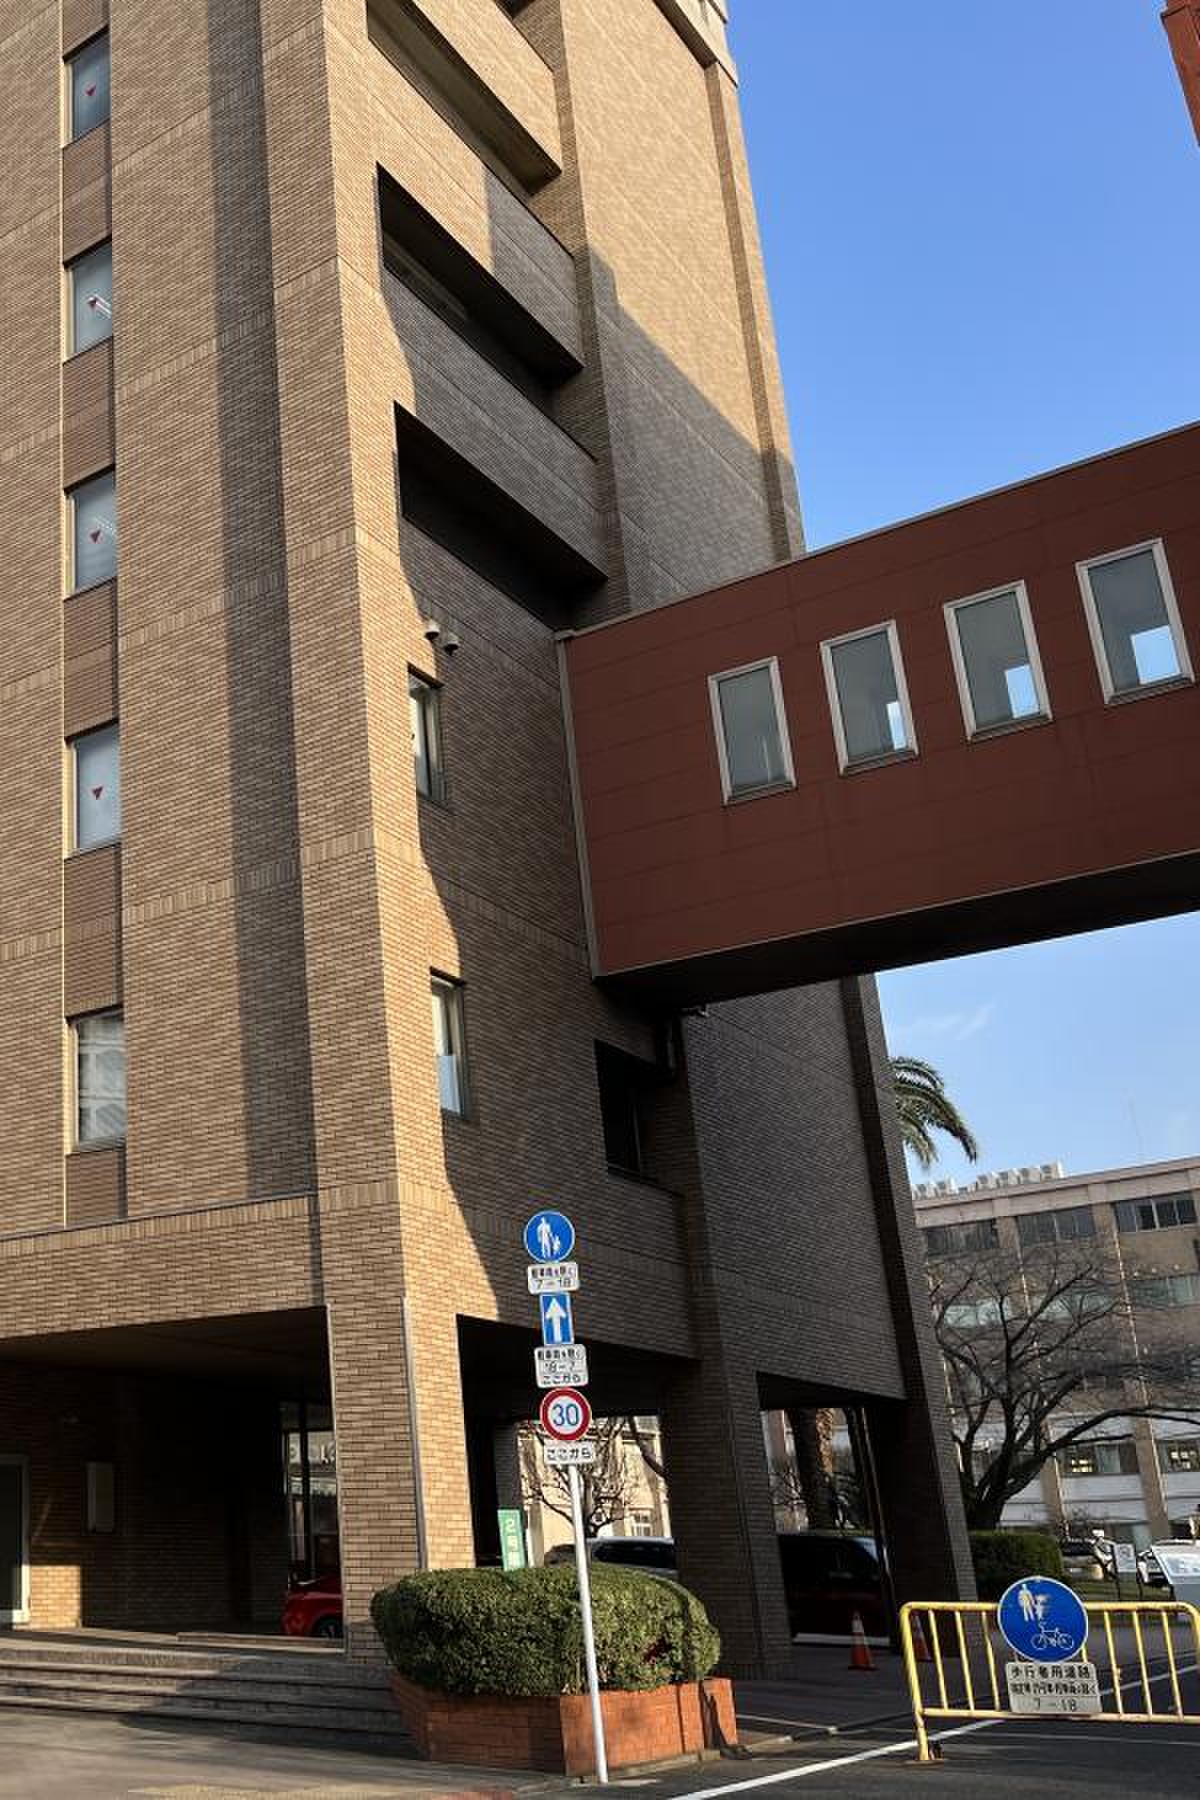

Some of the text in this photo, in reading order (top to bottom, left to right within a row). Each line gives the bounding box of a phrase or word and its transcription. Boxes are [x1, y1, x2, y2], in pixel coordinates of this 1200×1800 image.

[553, 1404, 580, 1426] 30
[547, 1447, 592, 1462] ここから
